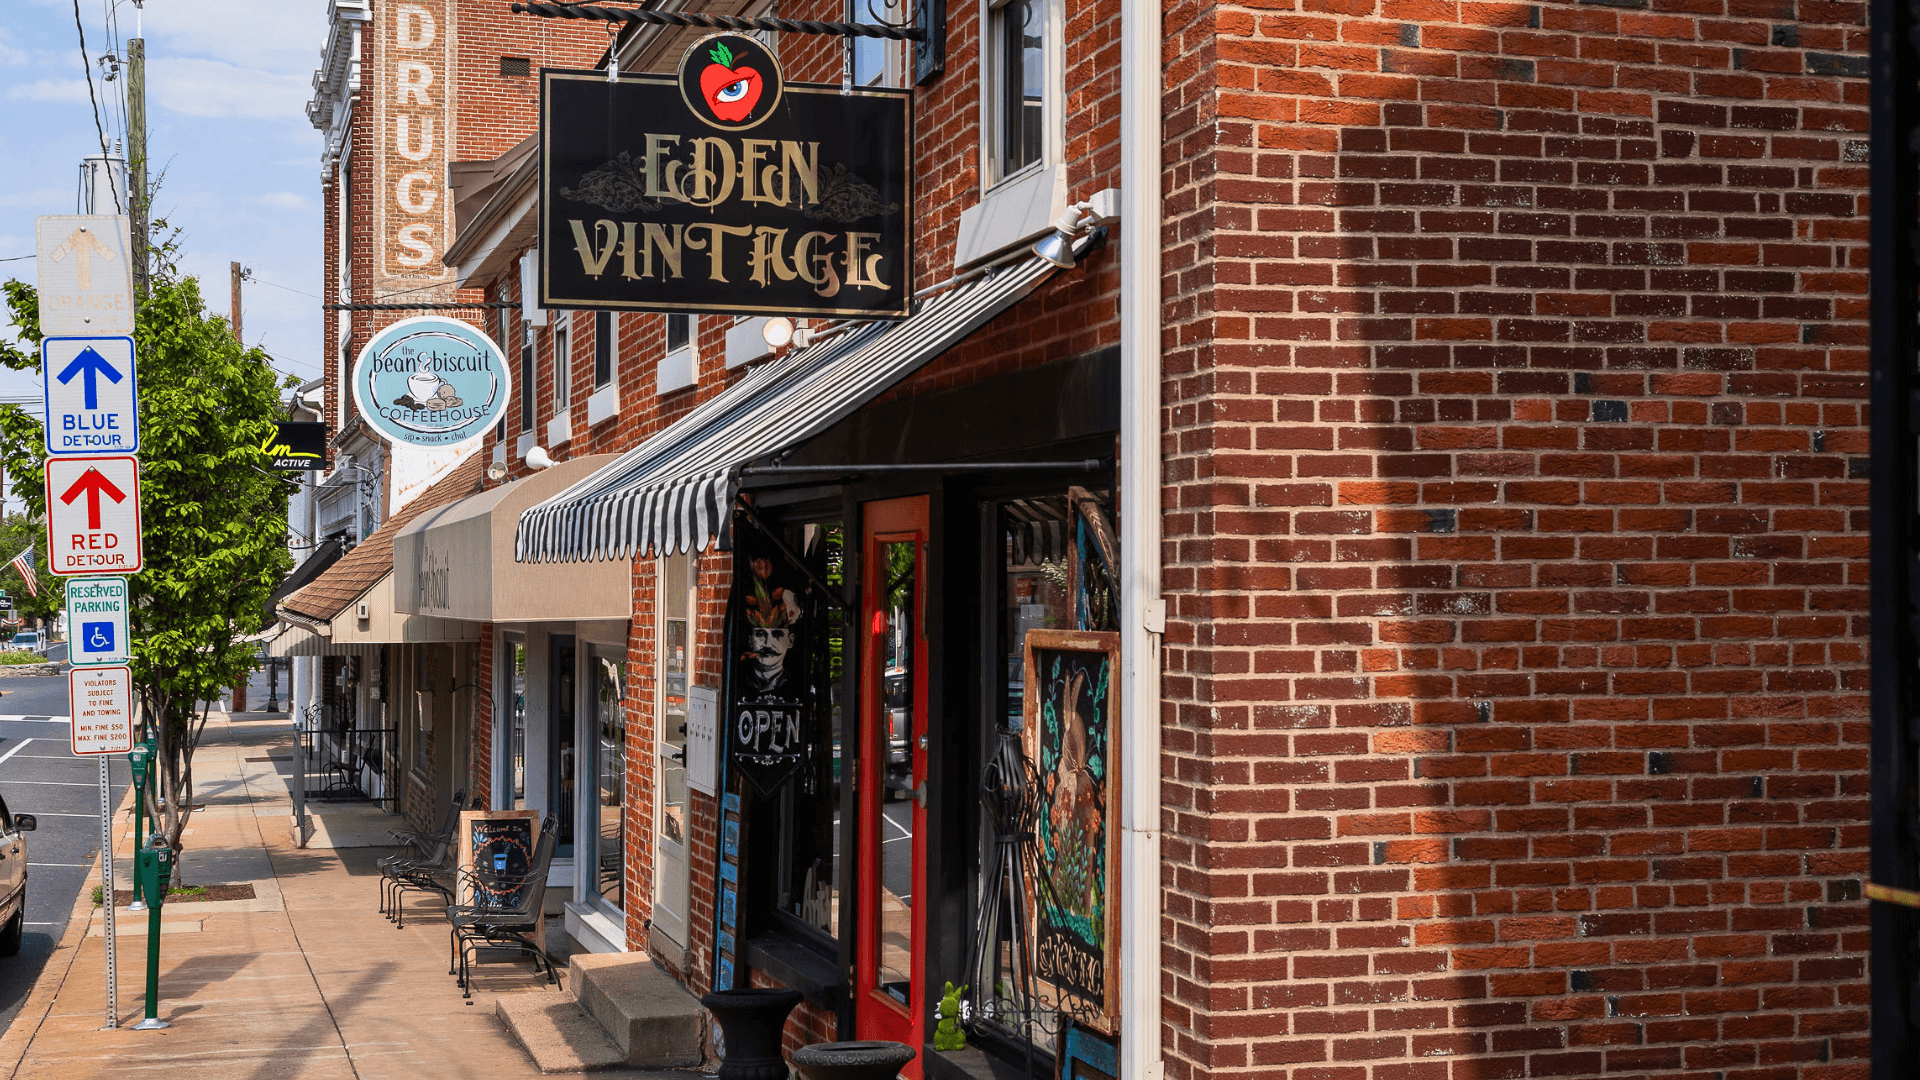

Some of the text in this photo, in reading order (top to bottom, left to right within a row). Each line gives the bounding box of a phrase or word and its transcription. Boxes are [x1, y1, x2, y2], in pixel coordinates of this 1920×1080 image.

[396, 4, 438, 268] DRUGS
[639, 132, 822, 214] EDEN
[567, 218, 893, 298] VINTAGE
[47, 293, 125, 311] ORANGE
[401, 346, 415, 356] the
[379, 404, 491, 423] COFFEEHOUSE
[63, 413, 119, 430] BLUE
[63, 434, 121, 446] DETOUR
[403, 430, 467, 443] sip snack chat
[273, 459, 311, 467] ACTIVE
[71, 533, 118, 550] RED
[66, 553, 125, 566] DETOUR
[70, 586, 123, 598] RESERVED
[74, 600, 120, 613] PARKING
[110, 733, 127, 741] $200
[737, 709, 800, 754] OPEN
